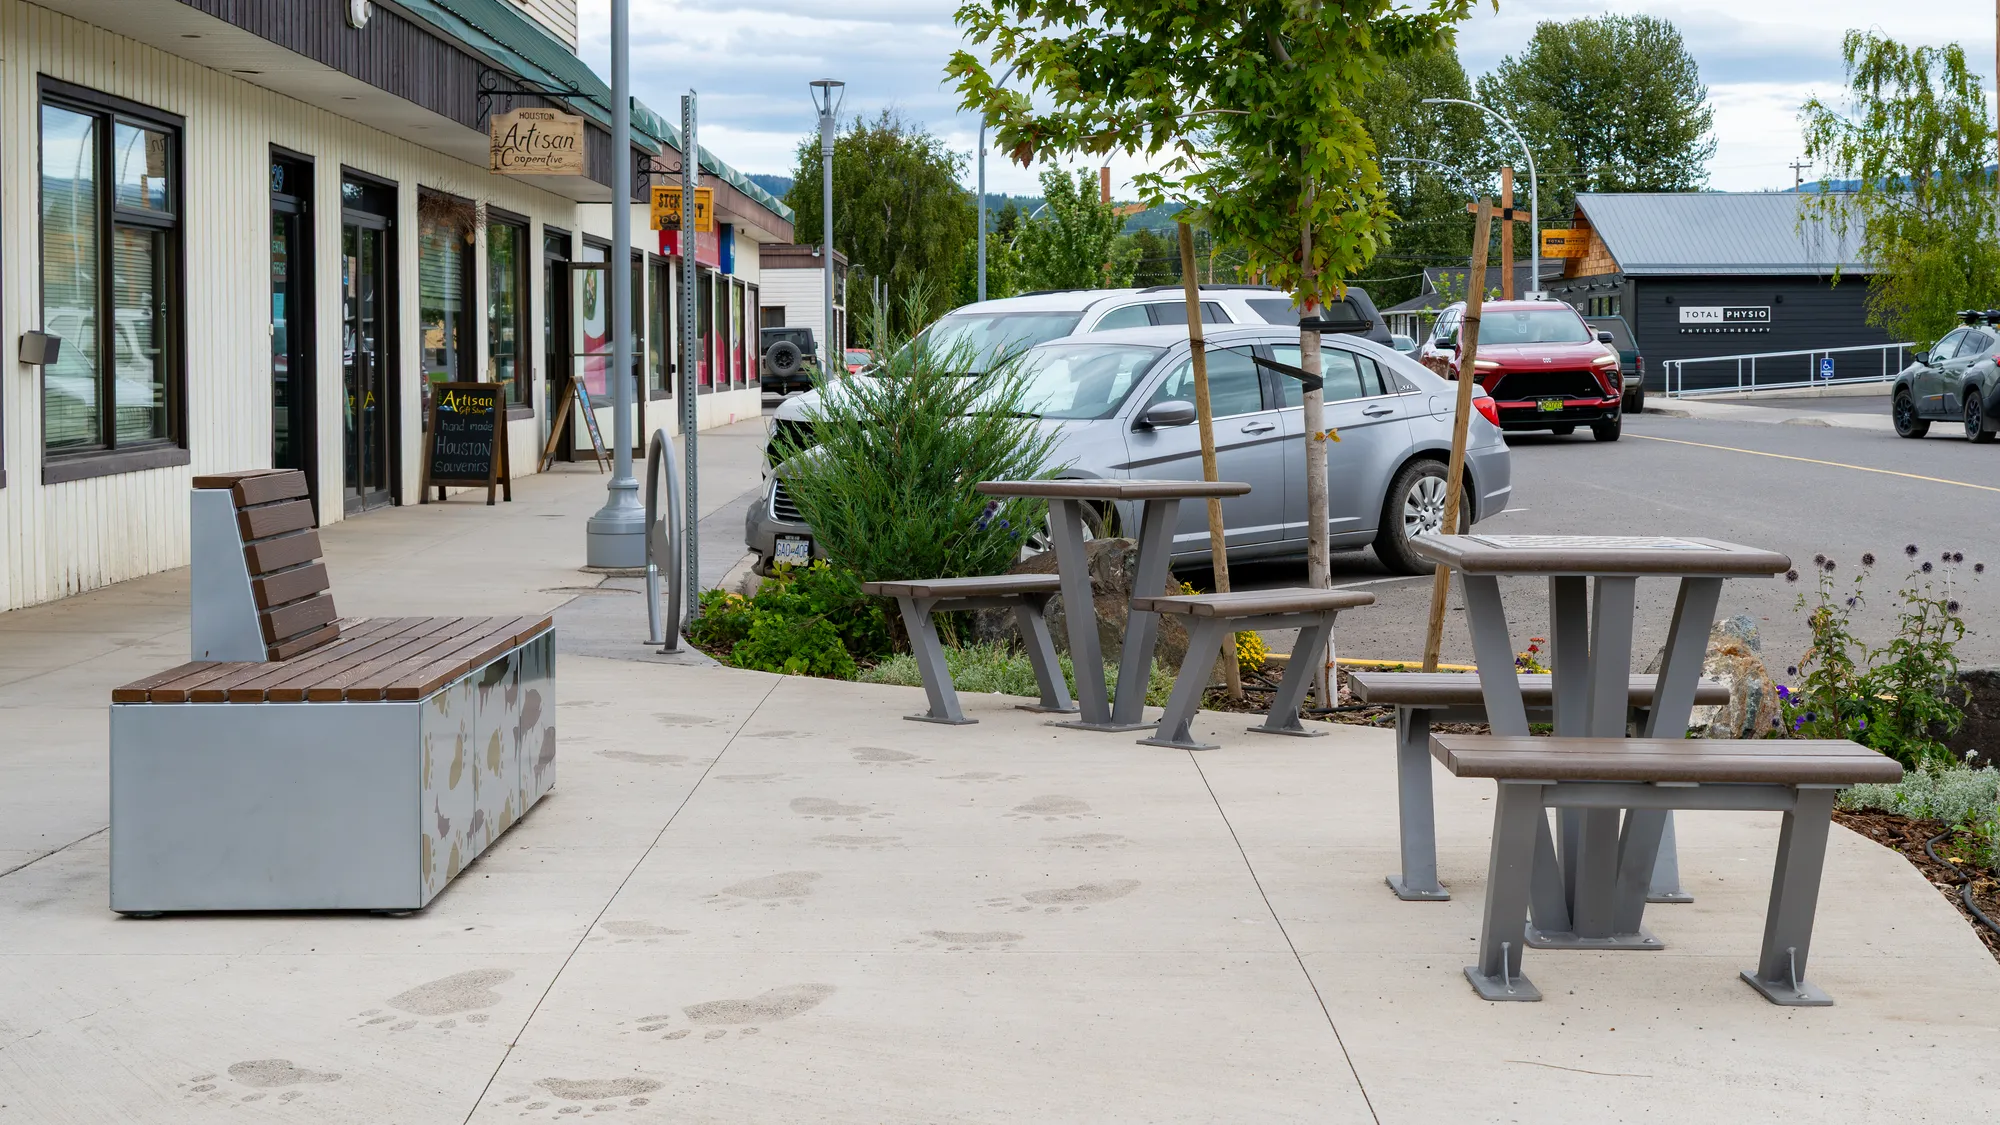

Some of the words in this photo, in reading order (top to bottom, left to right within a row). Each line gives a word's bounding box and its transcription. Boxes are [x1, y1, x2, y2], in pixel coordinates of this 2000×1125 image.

[519, 111, 555, 120] HOUSTON
[500, 122, 575, 154] Artisan
[501, 147, 563, 167] Cooperative
[1726, 310, 1767, 318] PHYSIO
[442, 390, 494, 412] Artisan
[442, 419, 465, 431] hand
[469, 421, 493, 431] made
[434, 460, 489, 473] Souvenirs
